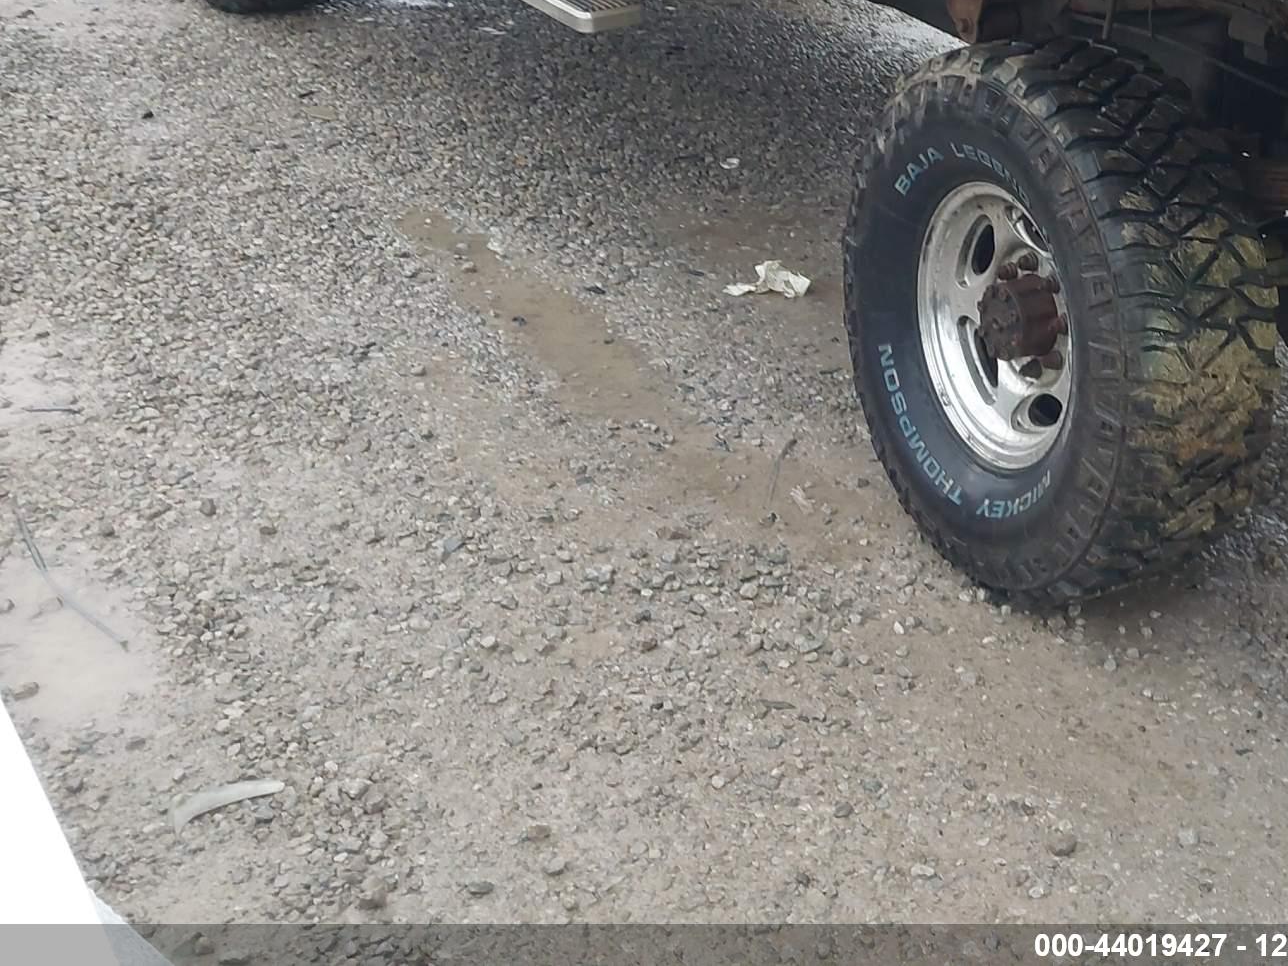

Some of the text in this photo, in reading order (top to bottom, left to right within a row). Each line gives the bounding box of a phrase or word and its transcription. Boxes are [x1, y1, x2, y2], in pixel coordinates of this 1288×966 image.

[893, 141, 1032, 209] BAJA LEGEND
[878, 344, 1051, 518] MICKEY THOMPSON
